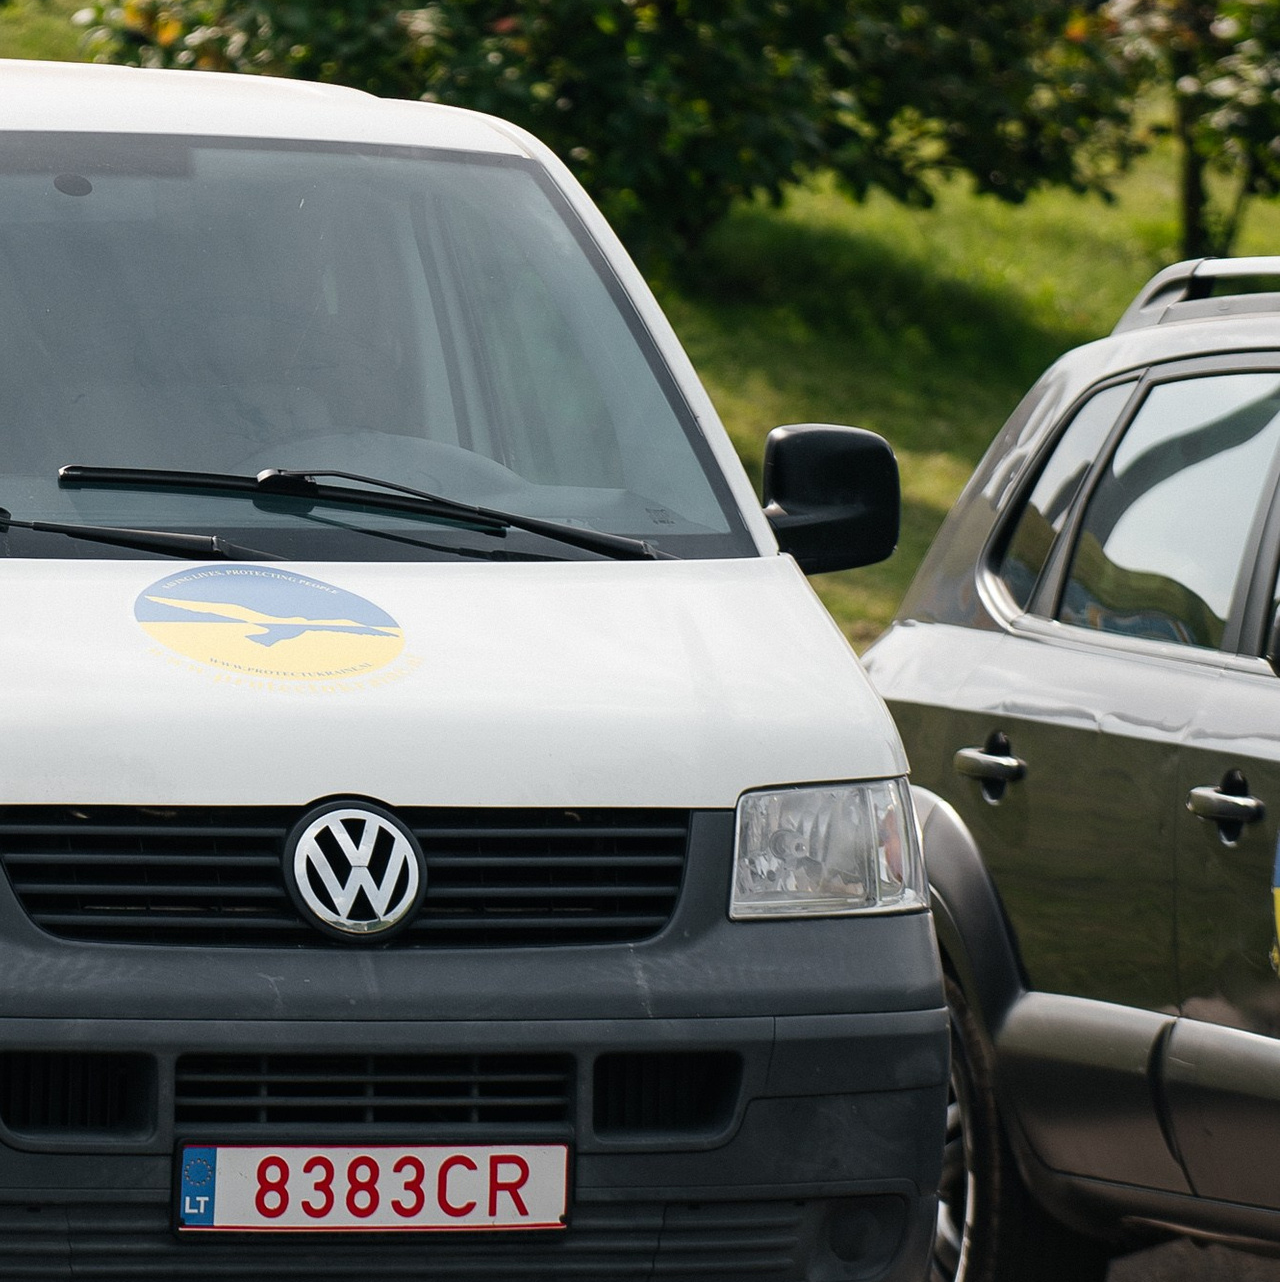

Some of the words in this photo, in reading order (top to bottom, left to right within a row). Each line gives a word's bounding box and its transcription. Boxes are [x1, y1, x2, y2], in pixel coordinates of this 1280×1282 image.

[225, 569, 297, 584] PROTECTING
[296, 810, 418, 931] VW
[184, 1196, 209, 1214] LT
[254, 1153, 530, 1219] 8383CR
